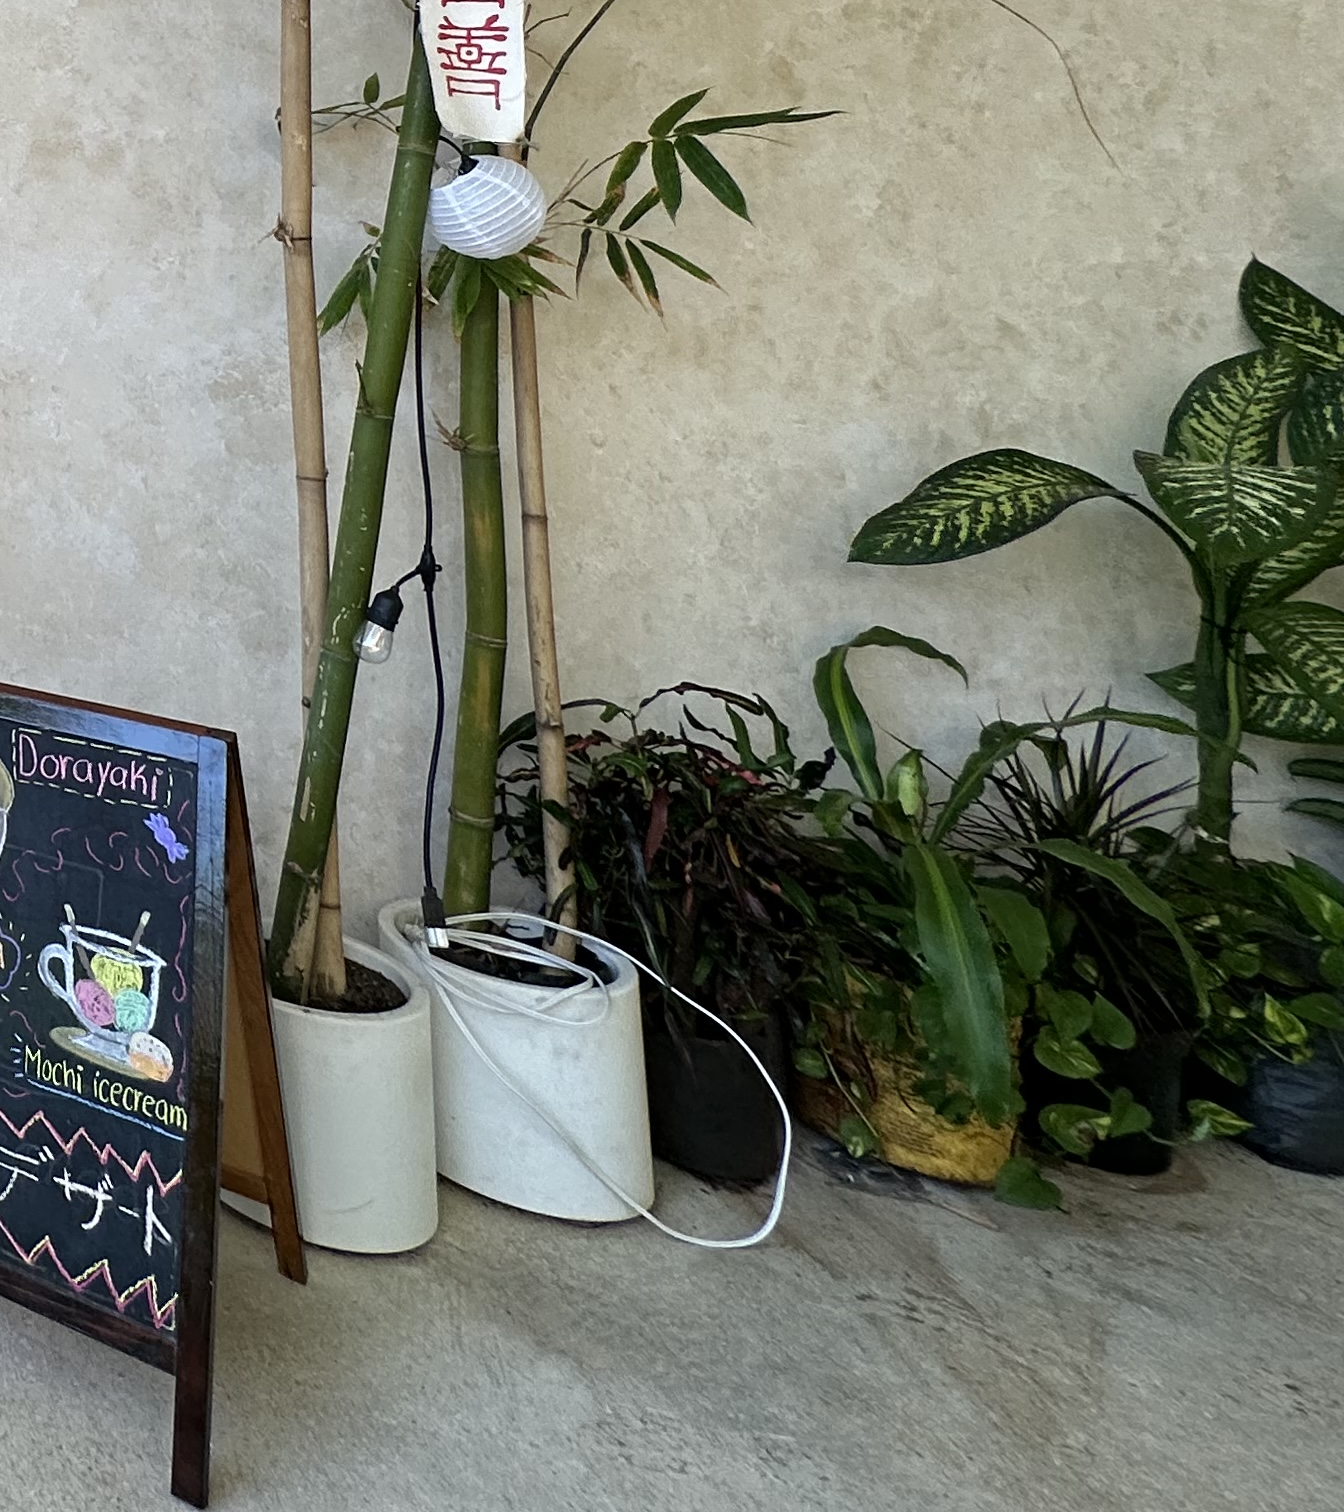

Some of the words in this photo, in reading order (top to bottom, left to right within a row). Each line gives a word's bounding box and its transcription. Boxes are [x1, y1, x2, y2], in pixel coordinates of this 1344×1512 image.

[18, 734, 162, 801] Dorayaki
[24, 1045, 85, 1094] Mochi
[93, 1071, 188, 1131] icecream
